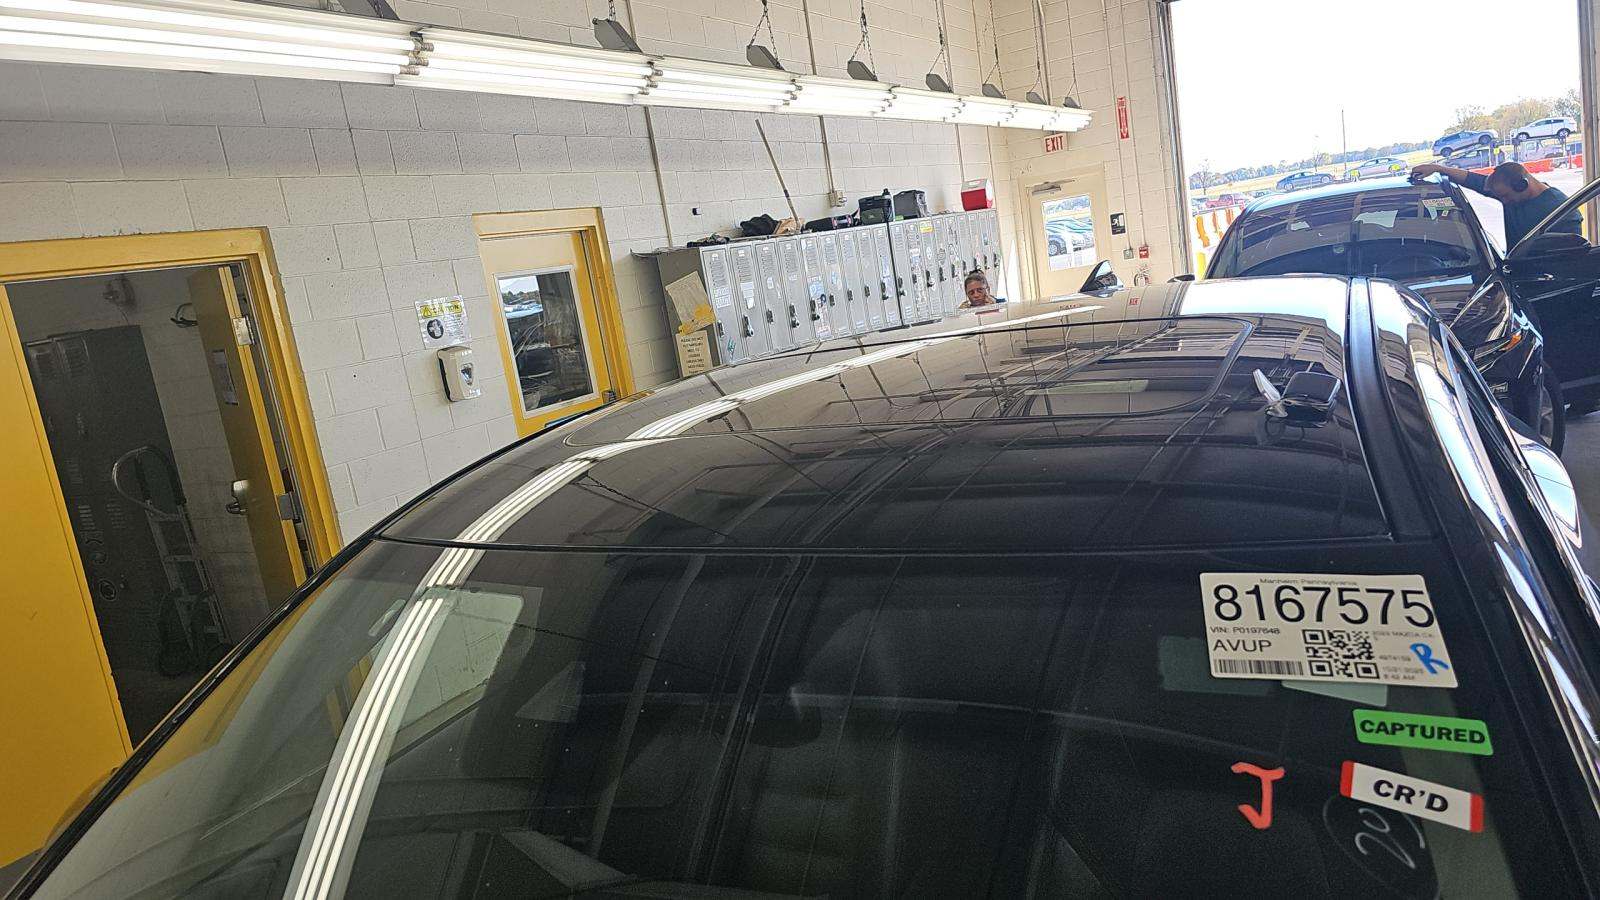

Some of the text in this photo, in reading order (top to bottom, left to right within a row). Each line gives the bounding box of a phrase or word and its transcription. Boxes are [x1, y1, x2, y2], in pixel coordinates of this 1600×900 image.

[1045, 136, 1063, 152] EXIT
[1213, 584, 1435, 628] 8167575
[1210, 626, 1229, 634] VIN:
[1213, 639, 1272, 653] AVUP
[1409, 642, 1450, 675] R
[1359, 718, 1486, 746] CAPTURED
[1230, 761, 1285, 830] J
[1373, 779, 1449, 813] CR'D
